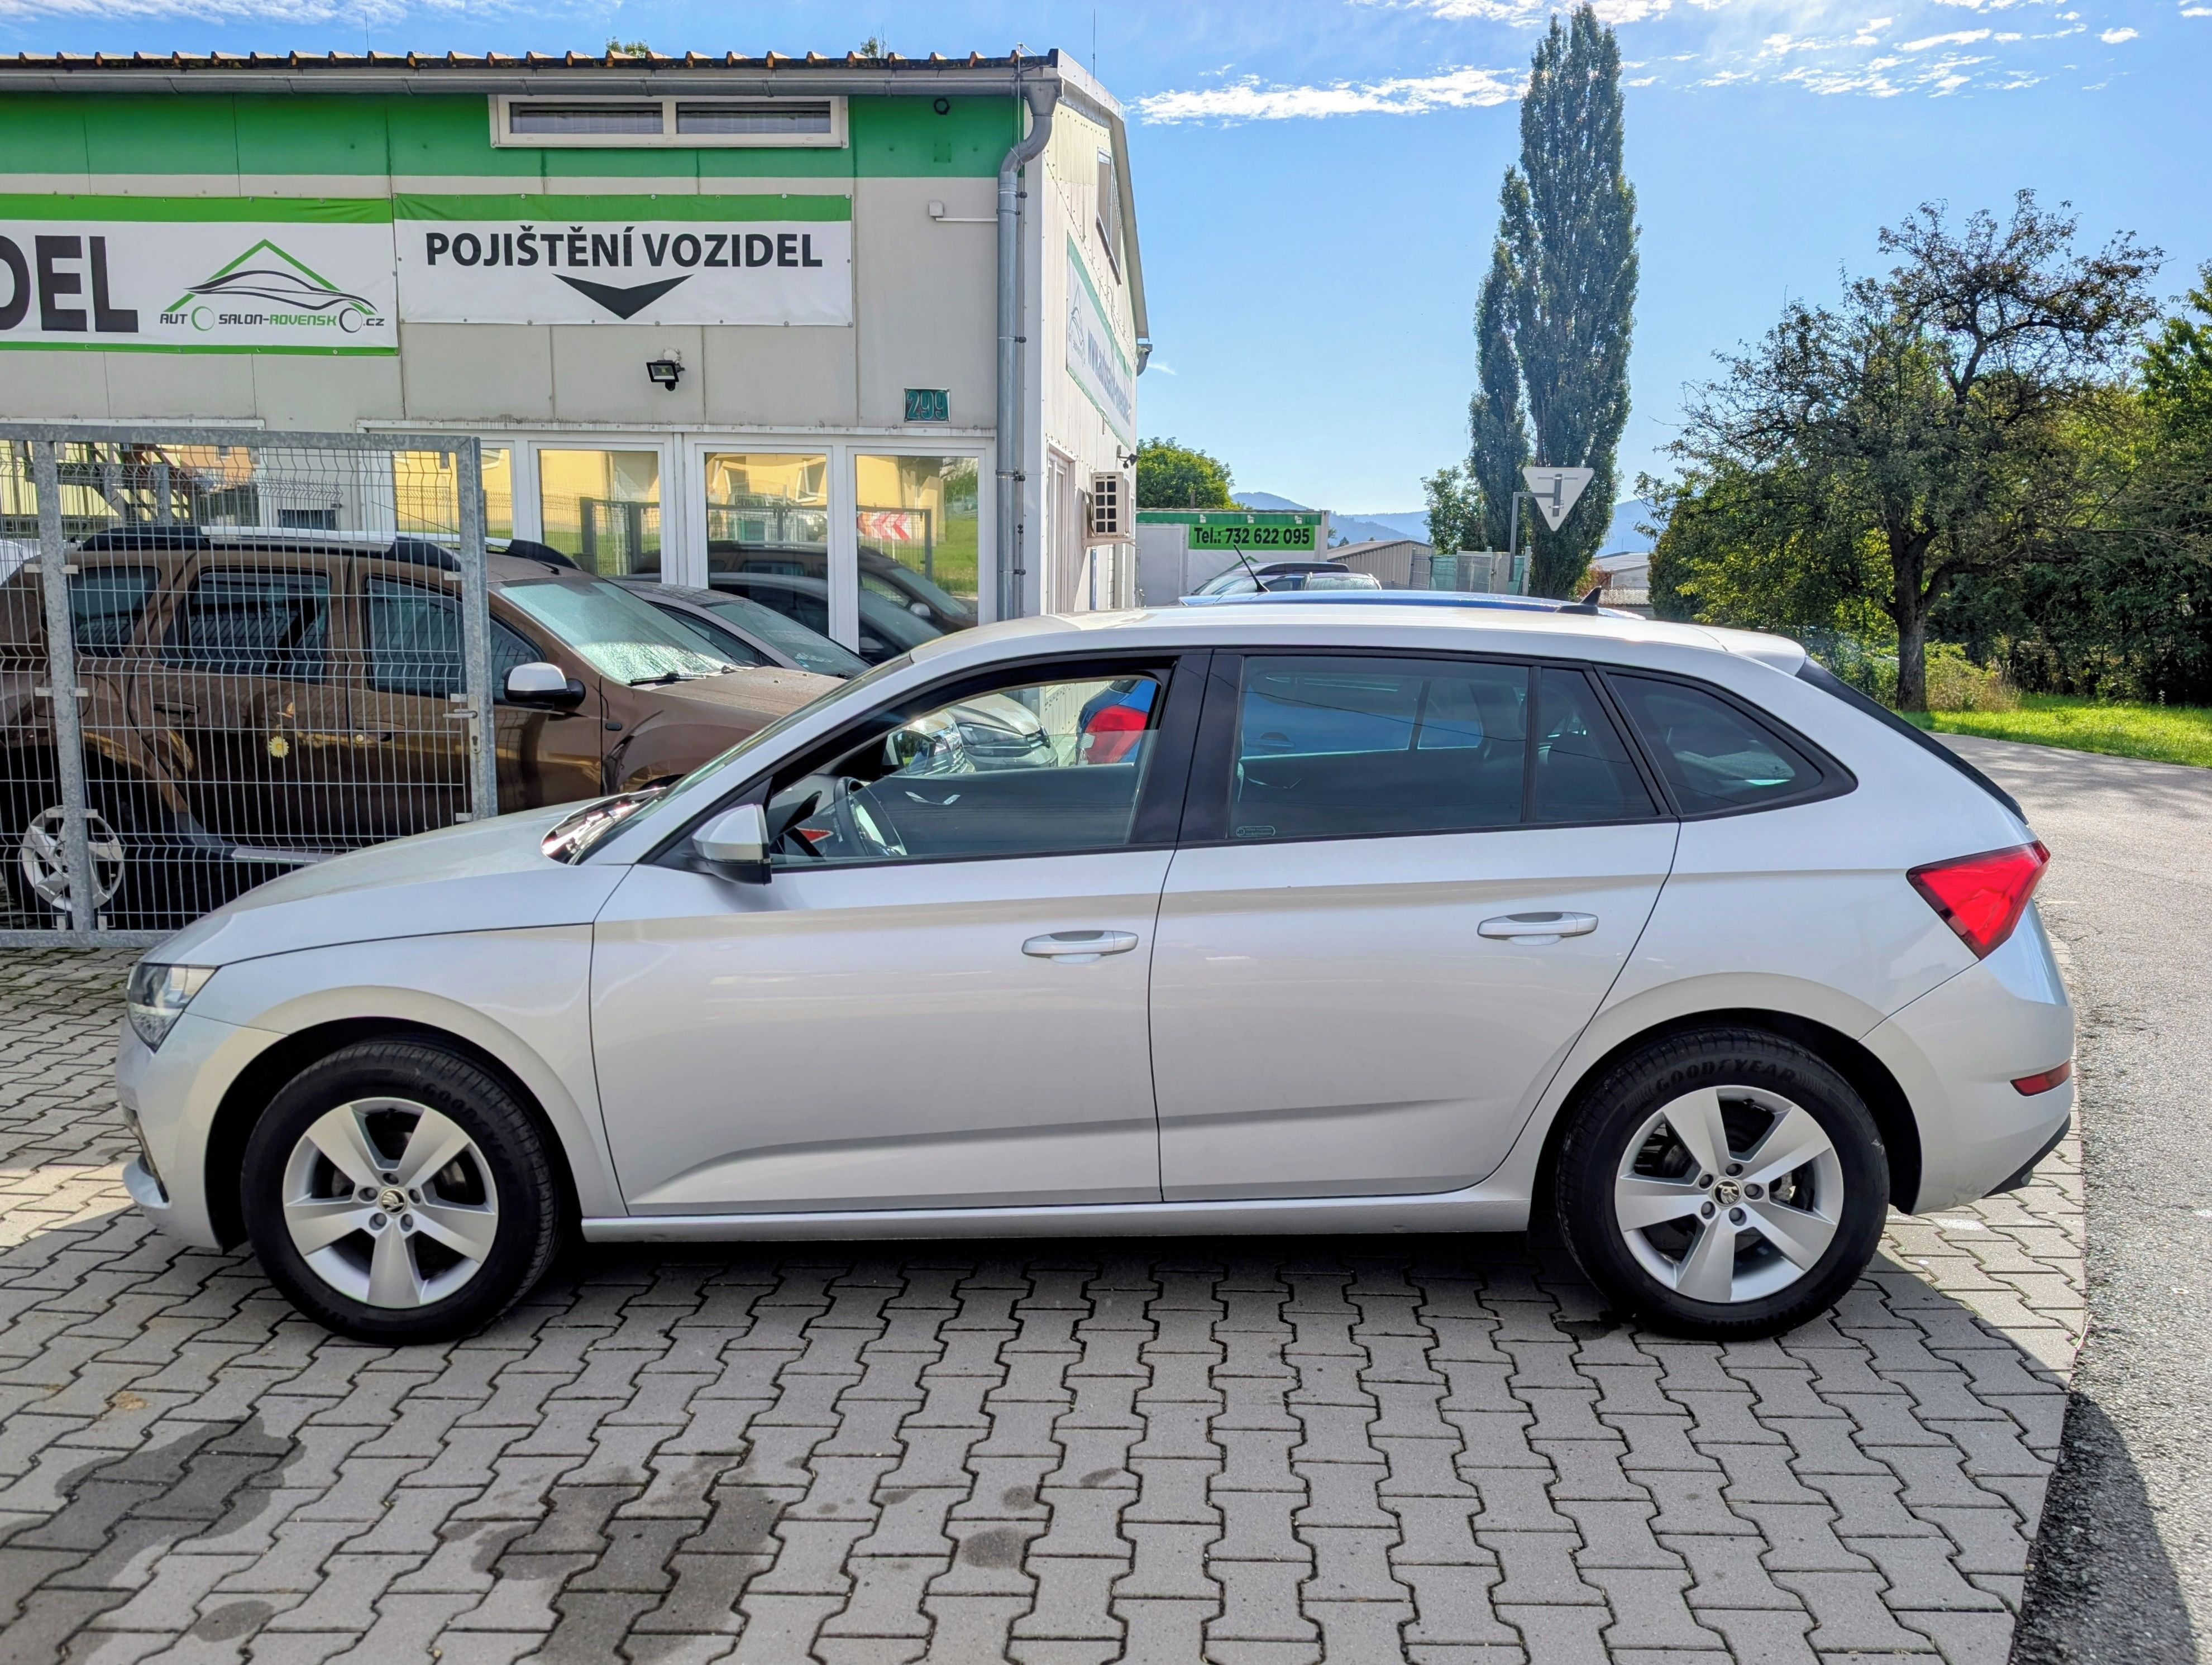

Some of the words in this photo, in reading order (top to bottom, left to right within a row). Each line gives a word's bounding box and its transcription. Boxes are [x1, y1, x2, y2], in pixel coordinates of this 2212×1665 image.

[426, 225, 636, 267] POJIŠTĚNÍ
[642, 233, 823, 267] VOZIDEL
[907, 390, 948, 419] 299
[1194, 527, 1221, 544] Tel.:
[1226, 528, 1250, 544] 732
[1254, 528, 1279, 544] 622
[1283, 528, 1310, 544] 095
